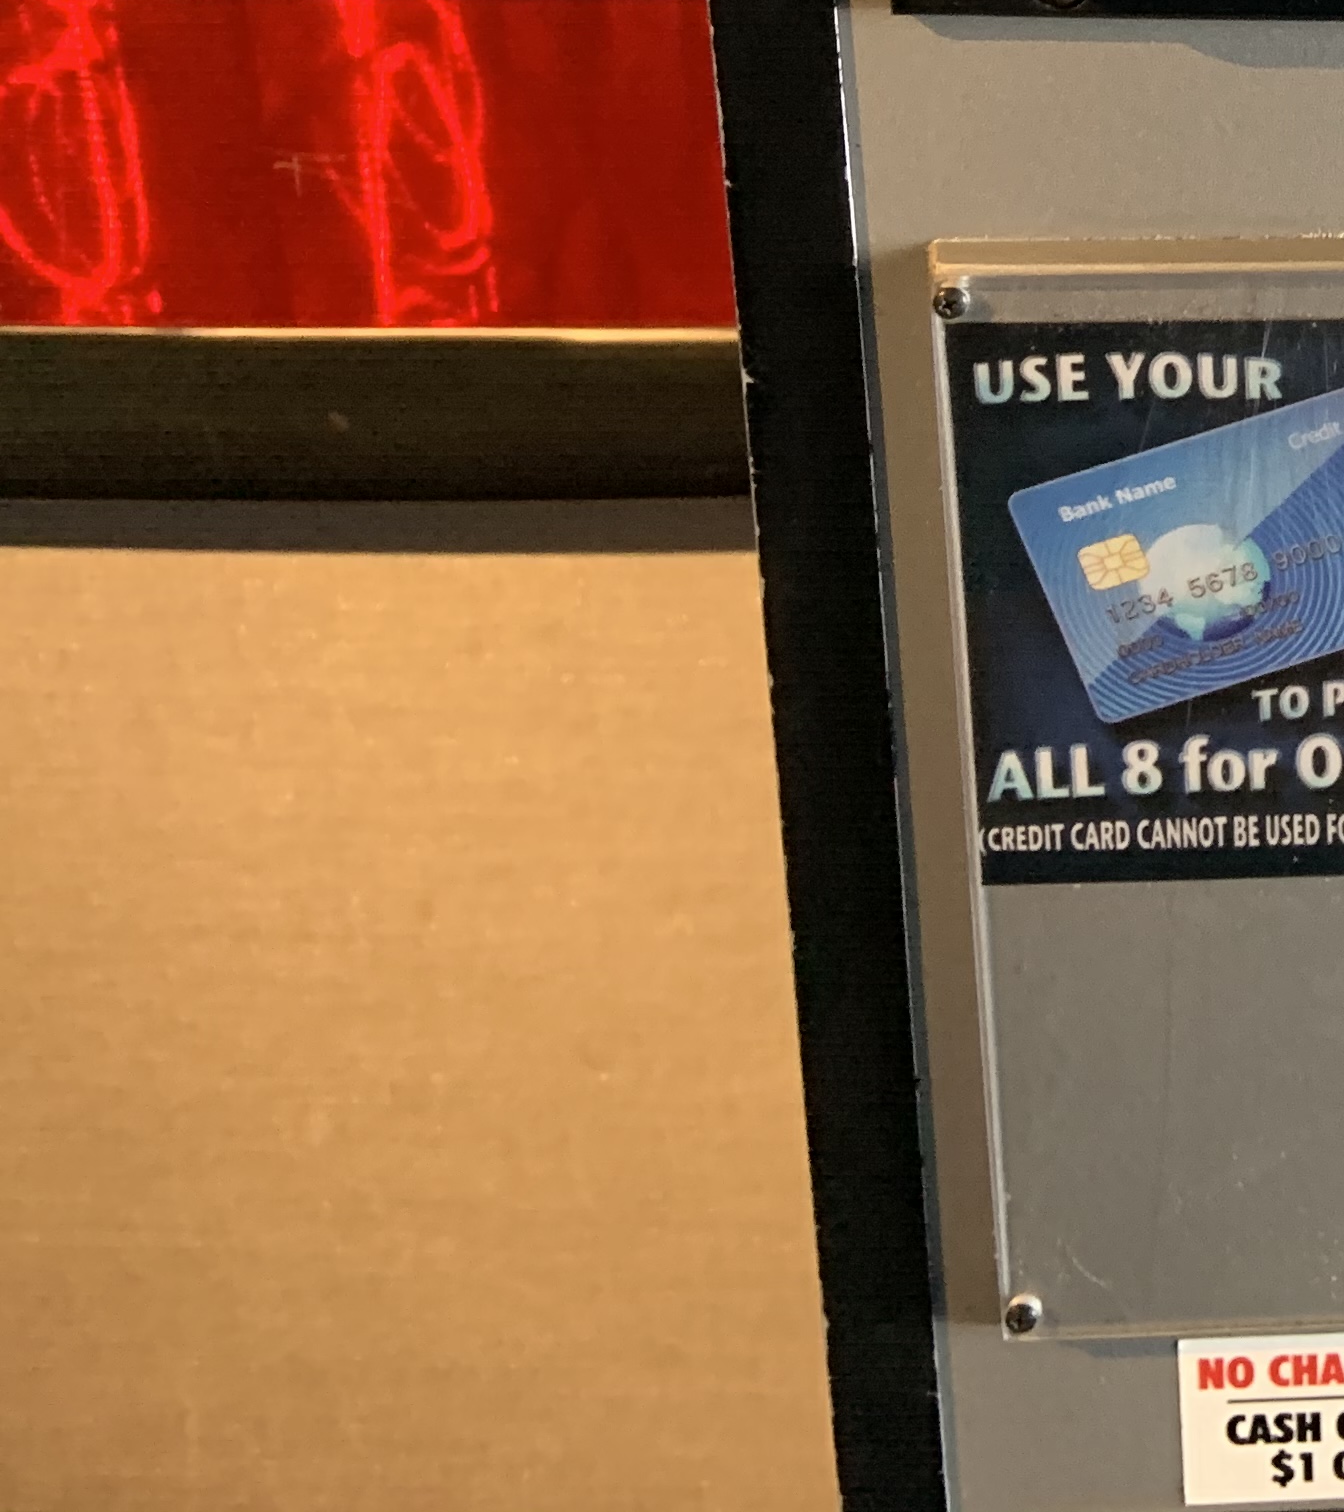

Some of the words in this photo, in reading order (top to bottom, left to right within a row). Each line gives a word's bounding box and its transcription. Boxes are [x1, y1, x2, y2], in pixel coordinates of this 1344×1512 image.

[973, 352, 1089, 404] USE
[1106, 352, 1282, 401] YOUR
[1288, 422, 1343, 450] Credit
[1058, 496, 1112, 523] Bank
[1116, 476, 1177, 505] Name
[1106, 587, 1175, 624] 1234
[1187, 562, 1258, 598] 5678
[1273, 534, 1342, 571] 9000
[1252, 686, 1309, 722] TO
[987, 744, 1105, 803] ALL
[1121, 740, 1163, 796] 8
[1179, 734, 1279, 794] for
[1070, 820, 1130, 851] CARD
[1136, 816, 1227, 850] CANNOT
[1233, 814, 1260, 848] BE
[1265, 813, 1320, 846] USED
[1197, 1356, 1254, 1391] NO
[1226, 1411, 1322, 1446] CASH
[1271, 1449, 1315, 1487] $1
